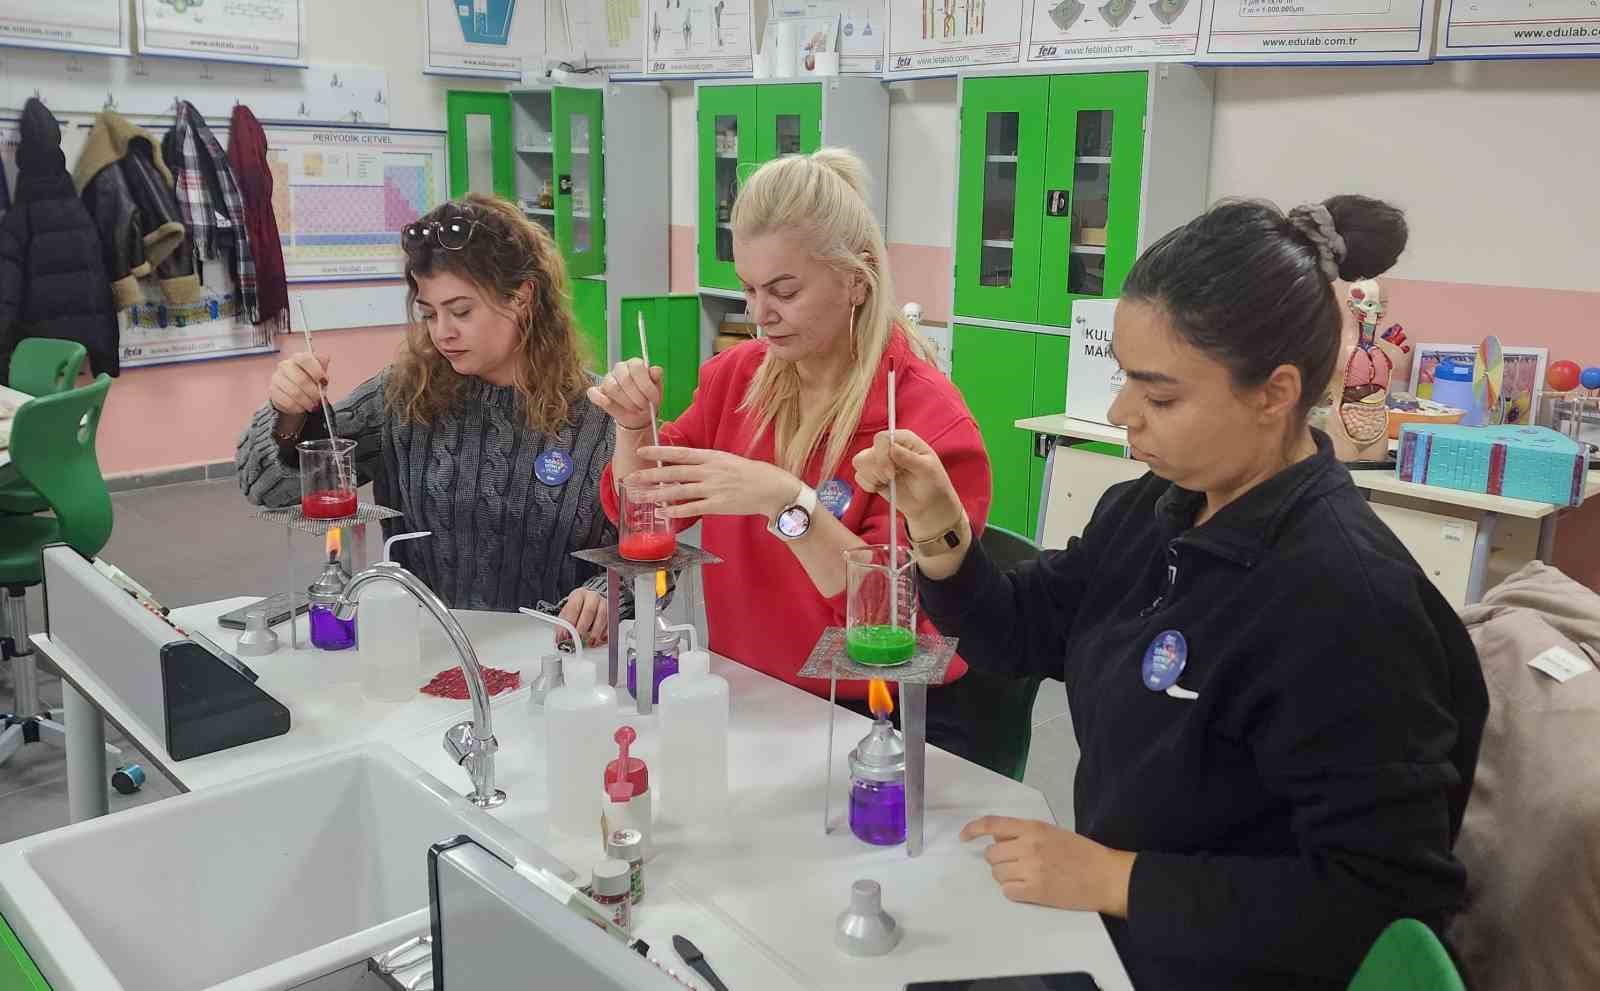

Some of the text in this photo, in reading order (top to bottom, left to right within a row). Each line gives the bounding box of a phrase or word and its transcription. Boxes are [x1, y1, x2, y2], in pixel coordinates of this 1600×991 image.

[1262, 36, 1358, 47] www.edulab.com.tr
[1038, 44, 1134, 58] feta www.fetalab.com
